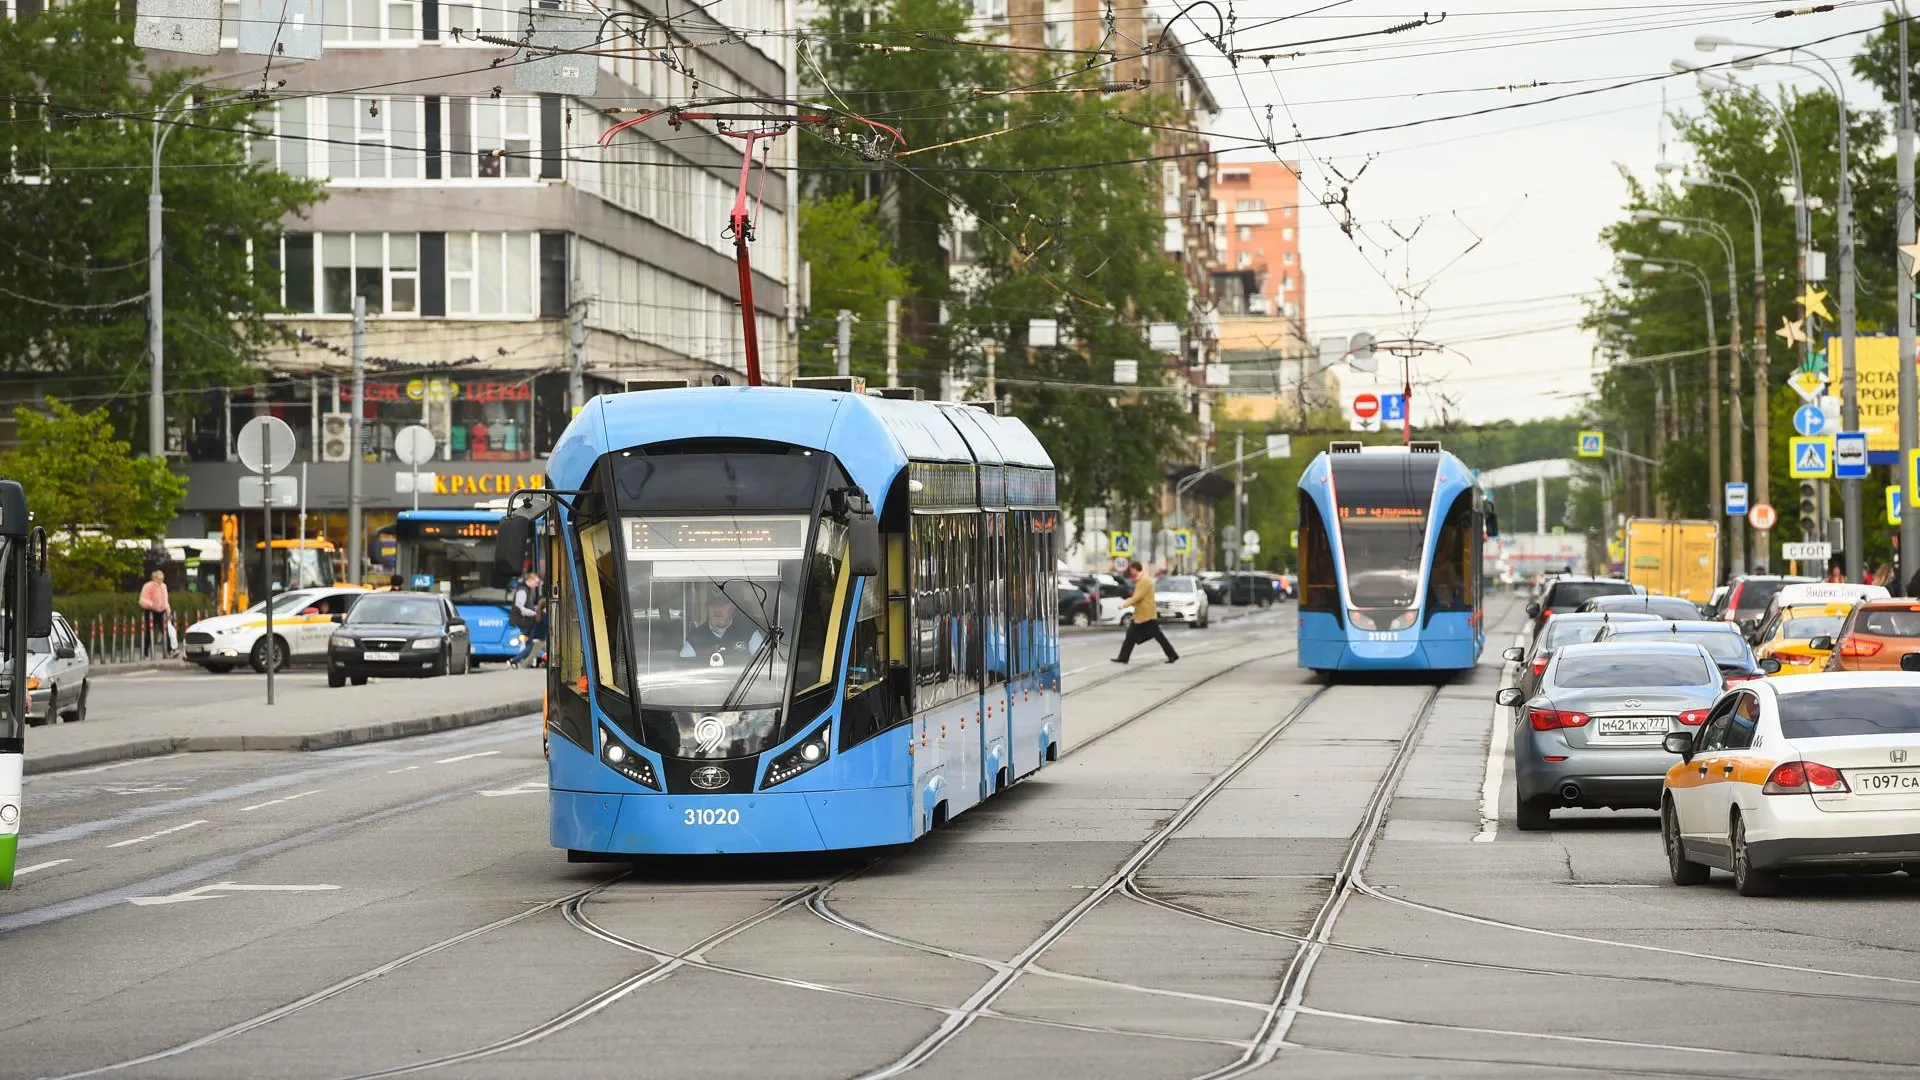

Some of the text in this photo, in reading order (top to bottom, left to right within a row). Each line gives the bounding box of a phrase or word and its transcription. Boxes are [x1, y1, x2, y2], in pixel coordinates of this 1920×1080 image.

[464, 381, 530, 404] ЦЕНА
[434, 473, 542, 495] КРАСНАЯ
[1789, 545, 1825, 557] СТОП
[1806, 586, 1838, 598] Яндекс
[1648, 718, 1665, 727] 777
[683, 808, 740, 825] 31020
